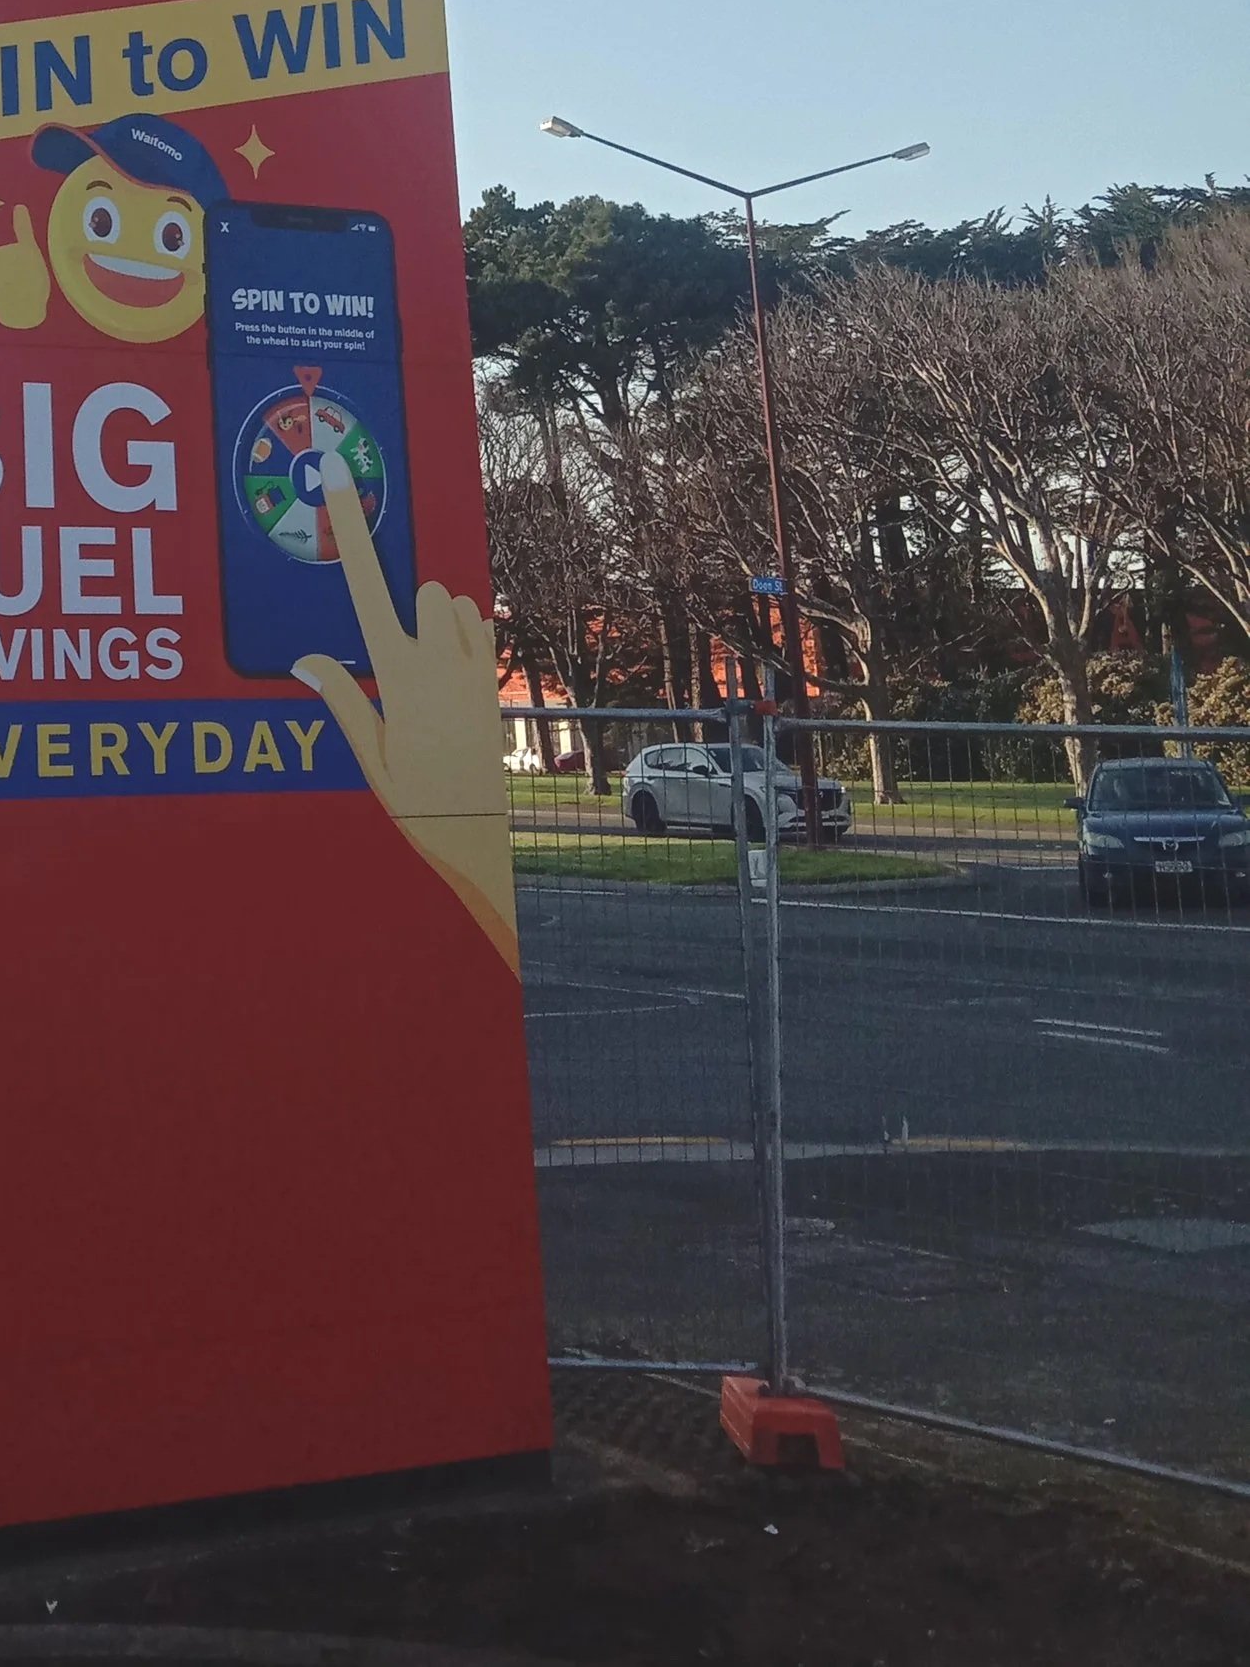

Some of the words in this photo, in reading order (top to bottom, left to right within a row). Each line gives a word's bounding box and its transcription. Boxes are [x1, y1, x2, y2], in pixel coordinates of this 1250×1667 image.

[122, 31, 208, 97] to
[131, 128, 183, 161] Waitomo
[232, 288, 284, 312] SPIN
[289, 292, 320, 314] TO
[325, 294, 374, 318] WIN!
[235, 322, 260, 332] Press
[261, 324, 276, 333] the
[278, 324, 306, 334] button
[308, 326, 317, 335] in
[319, 327, 333, 337] the
[334, 329, 364, 338] middle
[365, 330, 374, 339] of
[246, 335, 261, 344] the
[262, 336, 288, 346] wheel
[290, 338, 300, 346] to
[301, 339, 322, 348] start
[323, 341, 342, 350] your
[344, 341, 366, 351] spin!
